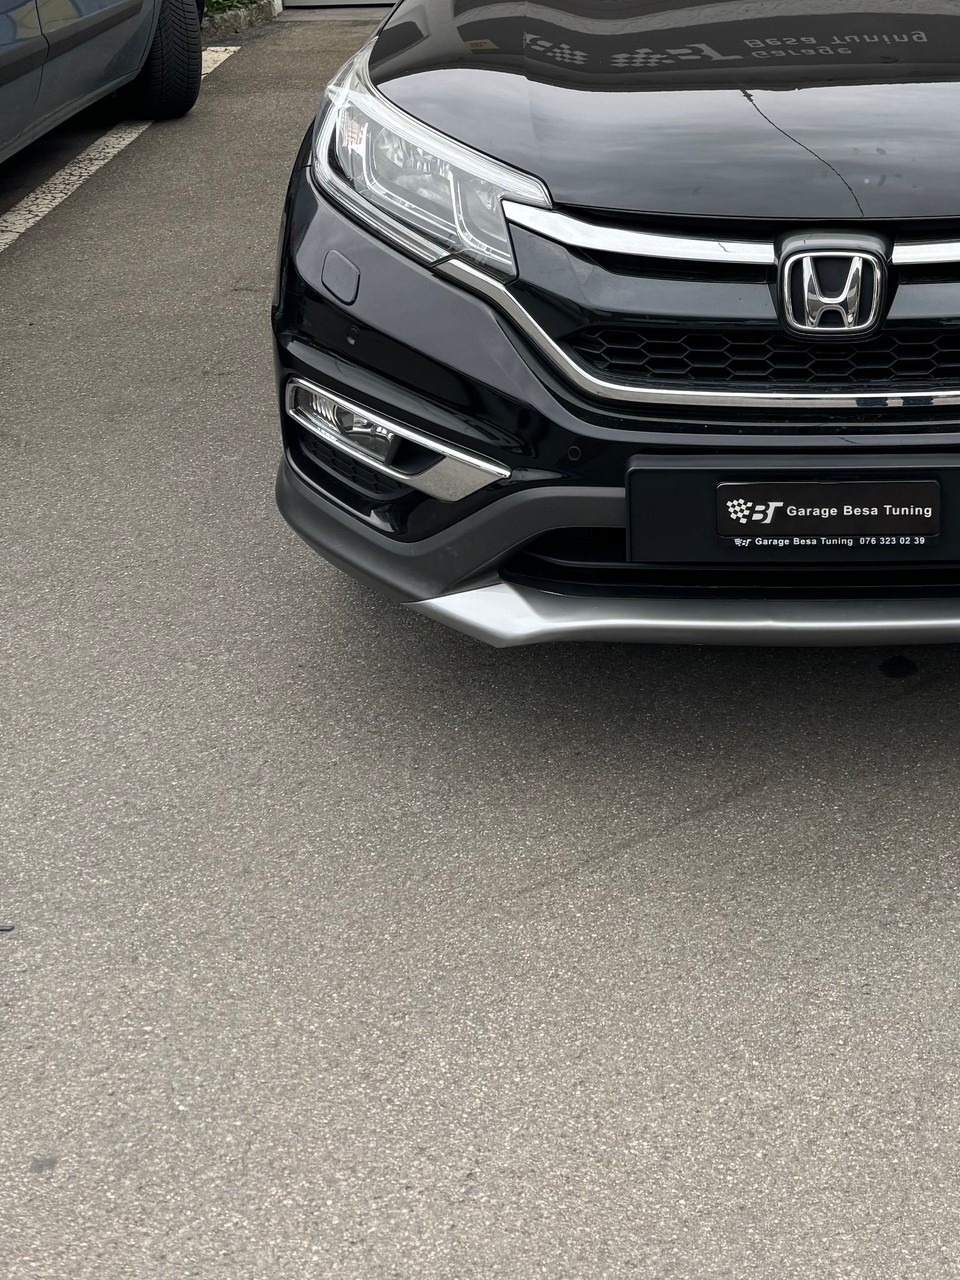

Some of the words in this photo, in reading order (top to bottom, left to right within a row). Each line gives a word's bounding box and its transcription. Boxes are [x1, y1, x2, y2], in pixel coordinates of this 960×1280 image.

[786, 505, 838, 518] Garage
[843, 505, 879, 516] Besa
[883, 505, 932, 518] Tuning
[755, 537, 790, 546] Garage
[793, 537, 817, 545] Besa
[820, 537, 854, 547] Tuning
[859, 536, 877, 545] 076
[879, 536, 897, 545] 323
[899, 536, 911, 545] 02
[913, 536, 926, 545] 39
